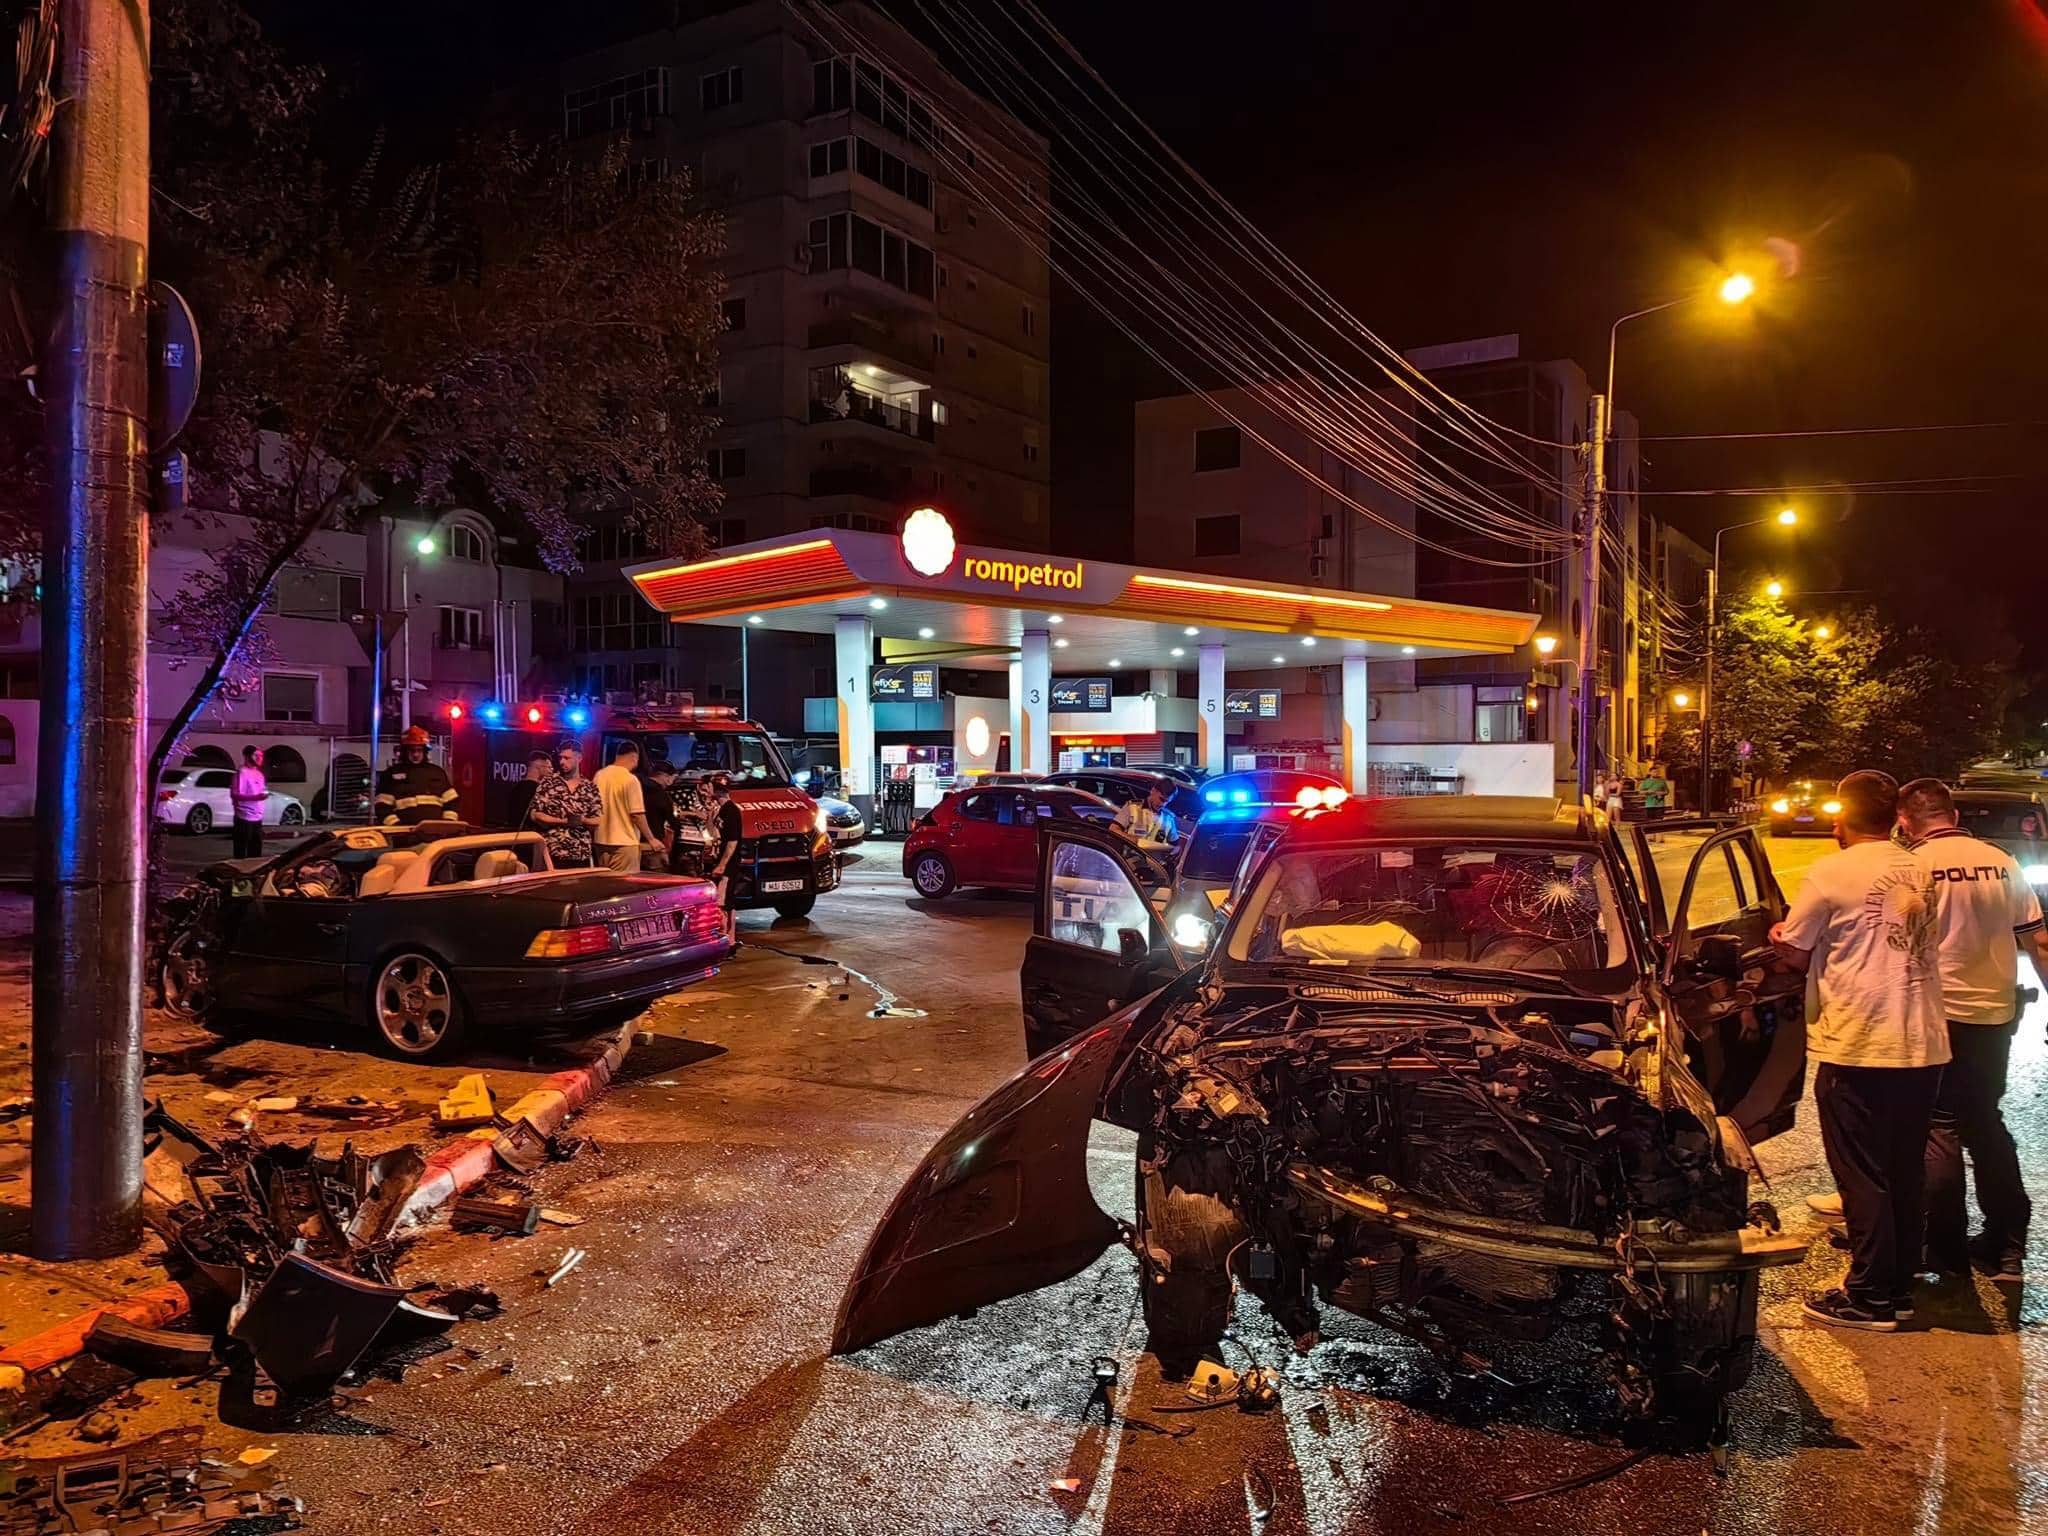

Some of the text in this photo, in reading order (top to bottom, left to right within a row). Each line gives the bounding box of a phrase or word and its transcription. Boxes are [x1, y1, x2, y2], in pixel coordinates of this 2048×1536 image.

[965, 558, 1083, 592] rompetrol
[848, 677, 854, 693] 1
[1030, 689, 1040, 703] 3
[1207, 699, 1216, 712] 5
[1931, 866, 2010, 882] POLITIA
